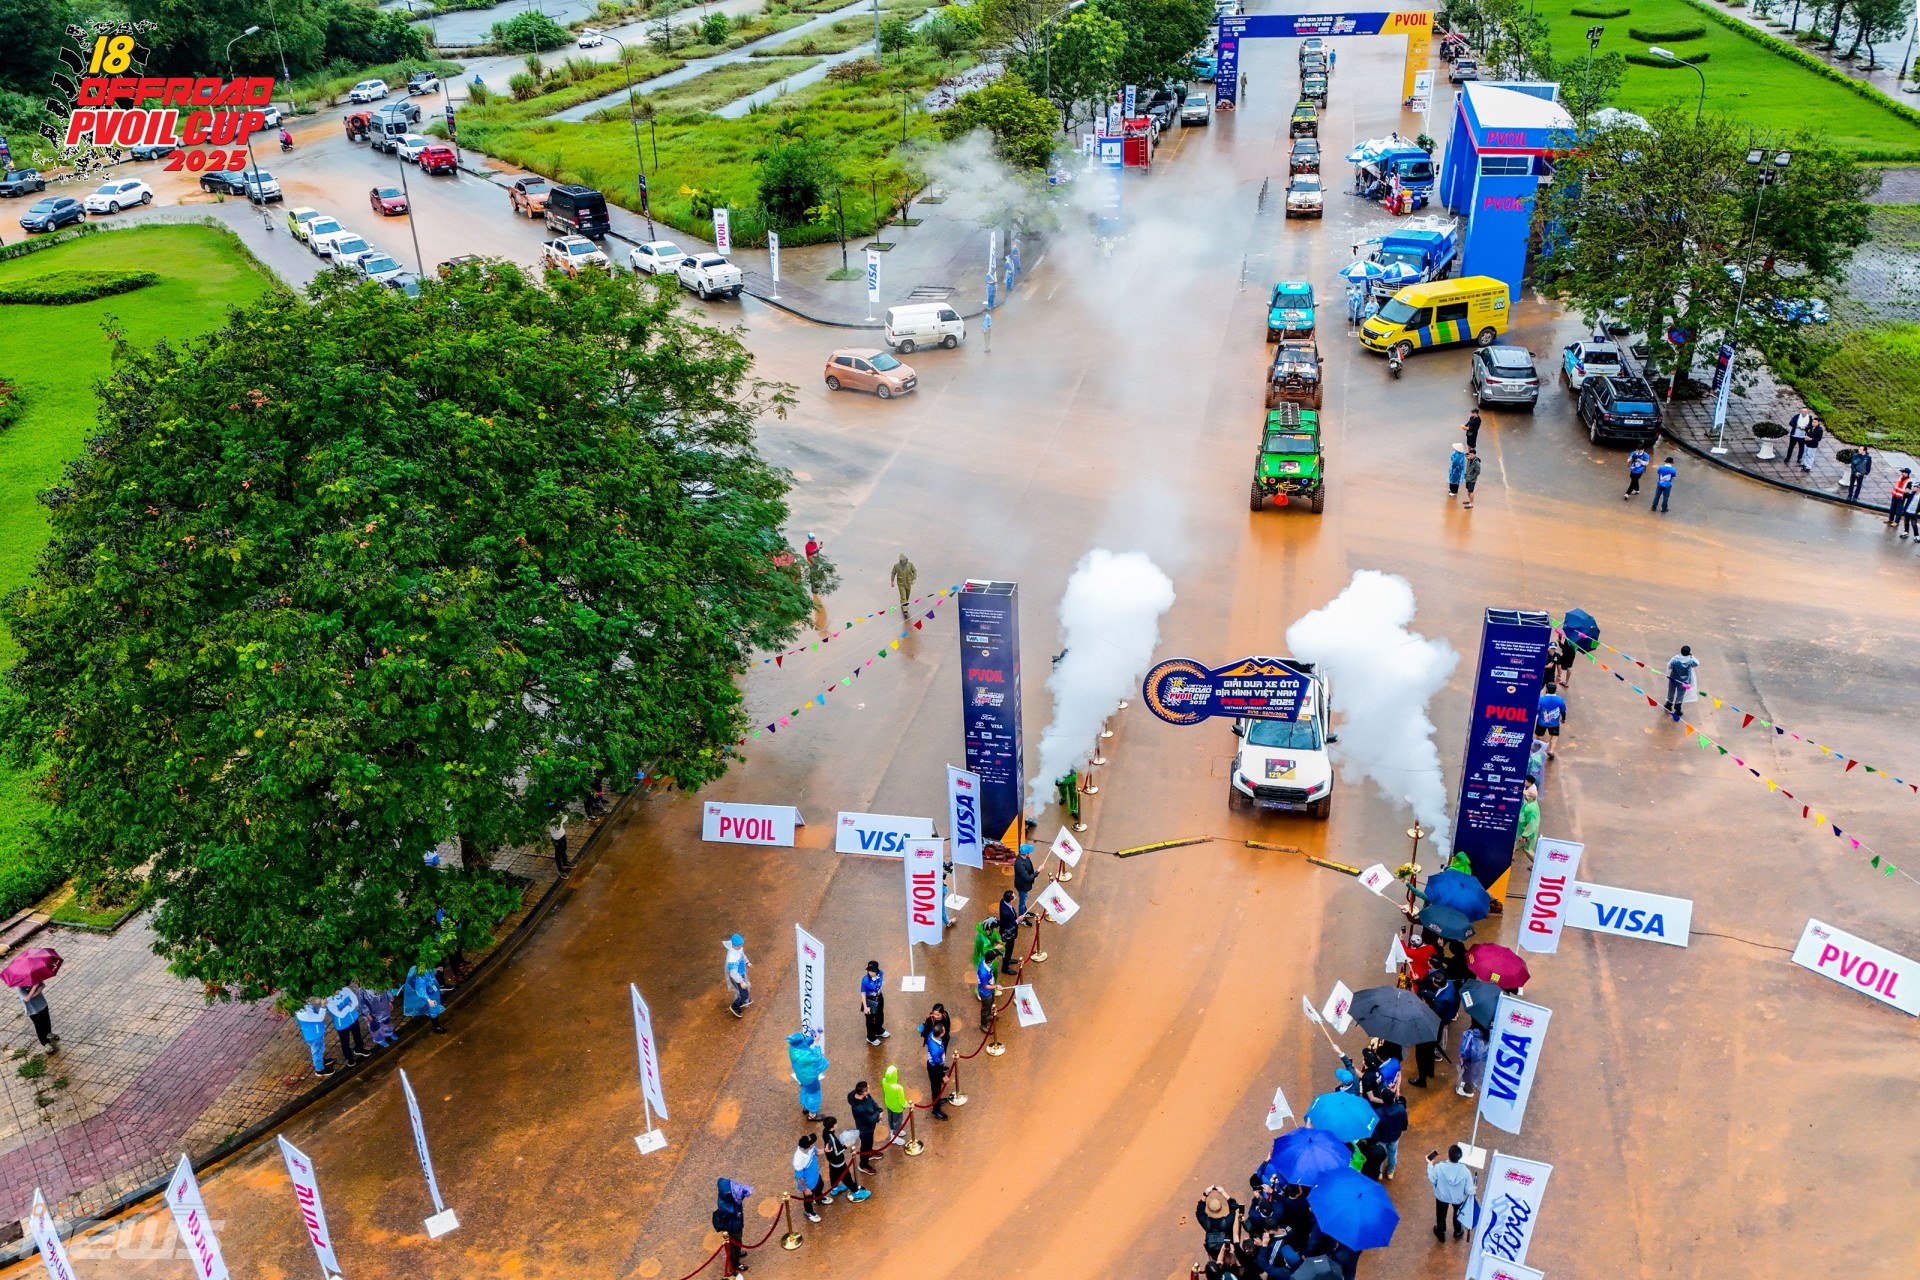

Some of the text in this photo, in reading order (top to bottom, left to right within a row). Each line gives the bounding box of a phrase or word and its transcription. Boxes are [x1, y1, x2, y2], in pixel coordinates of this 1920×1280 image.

[1395, 14, 1428, 26] PVOIL
[1486, 132, 1527, 146] PVOIL
[869, 264, 878, 291] VISA
[968, 668, 1004, 682] PVOIL
[1223, 678, 1241, 688] GIẢI
[1280, 680, 1300, 688] ÔTÔ
[1216, 688, 1230, 697] ĐỊA
[1232, 688, 1252, 696] HÌNH
[1254, 689, 1274, 698] VIỆT
[1486, 705, 1528, 722] PVOIL
[719, 817, 776, 840] PVOIL
[956, 794, 976, 848] VISA
[854, 829, 911, 852] VISA
[913, 869, 935, 926] PVOIL
[1528, 875, 1566, 934] PVOIL
[1590, 902, 1664, 937] VISA
[1817, 943, 1899, 999] PVOIL
[804, 965, 812, 1017] TOYOTA
[1487, 1032, 1532, 1100] VISA
[1482, 1193, 1531, 1262] Ford
